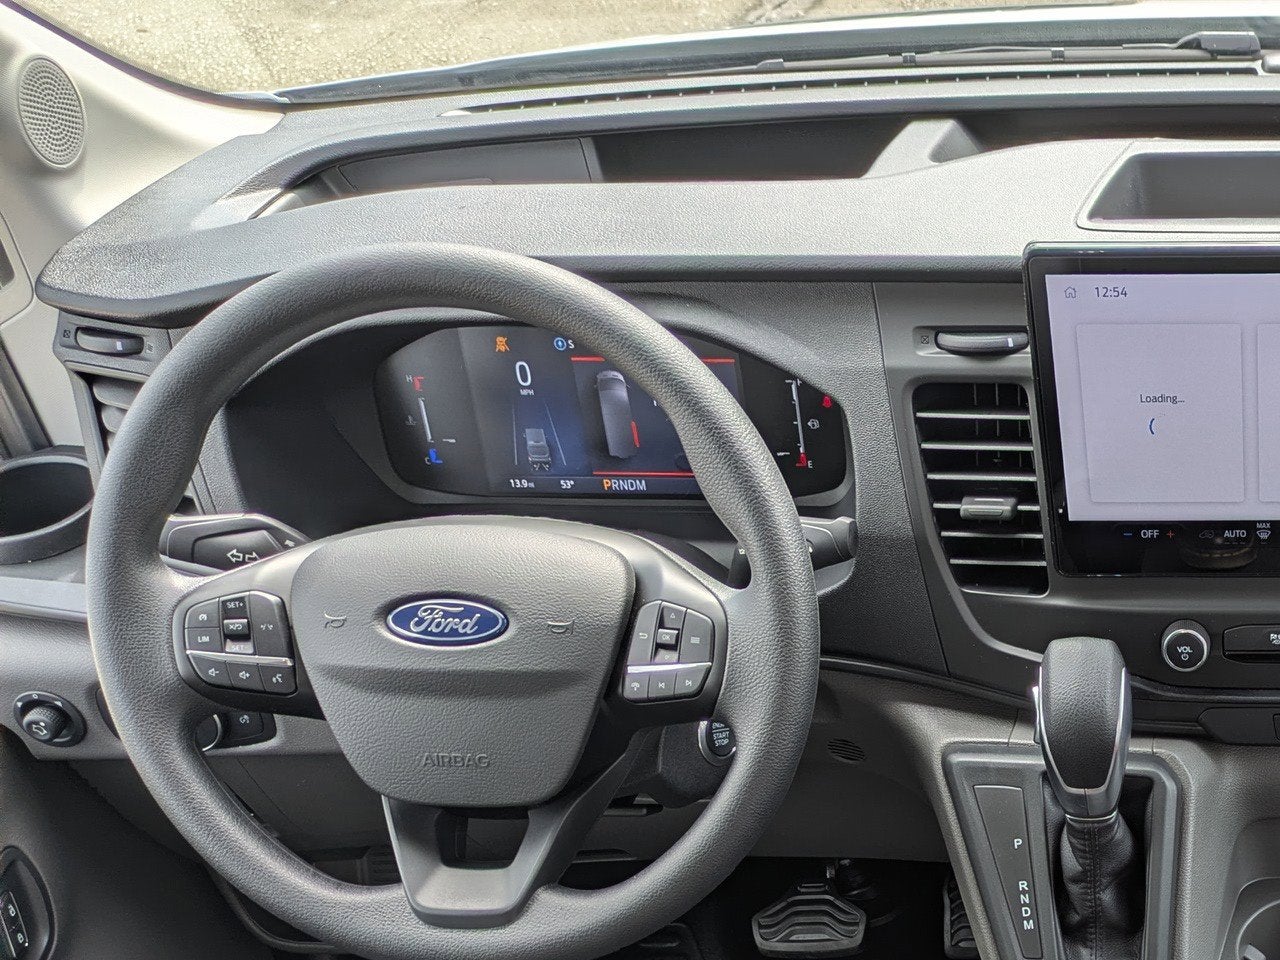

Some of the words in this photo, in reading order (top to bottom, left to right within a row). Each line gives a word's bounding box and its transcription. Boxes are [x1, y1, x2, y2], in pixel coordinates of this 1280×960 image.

[1094, 286, 1128, 298] 12:54
[515, 360, 532, 387] 0
[520, 388, 535, 396] MPH
[1139, 393, 1185, 405] Loading...
[602, 478, 647, 491] PRNDM
[1140, 529, 1160, 539] OFF
[1223, 529, 1247, 538] AUTO
[410, 604, 481, 634] Ford
[197, 635, 210, 643] LIM
[1176, 645, 1193, 653] VOL
[712, 731, 730, 740] START
[714, 738, 730, 747] STOP
[423, 752, 490, 768] AIRBAG
[1014, 838, 1023, 850] P
[1018, 881, 1029, 891] R
[1020, 893, 1030, 904] N
[1021, 906, 1031, 917] D
[1023, 919, 1035, 931] M
